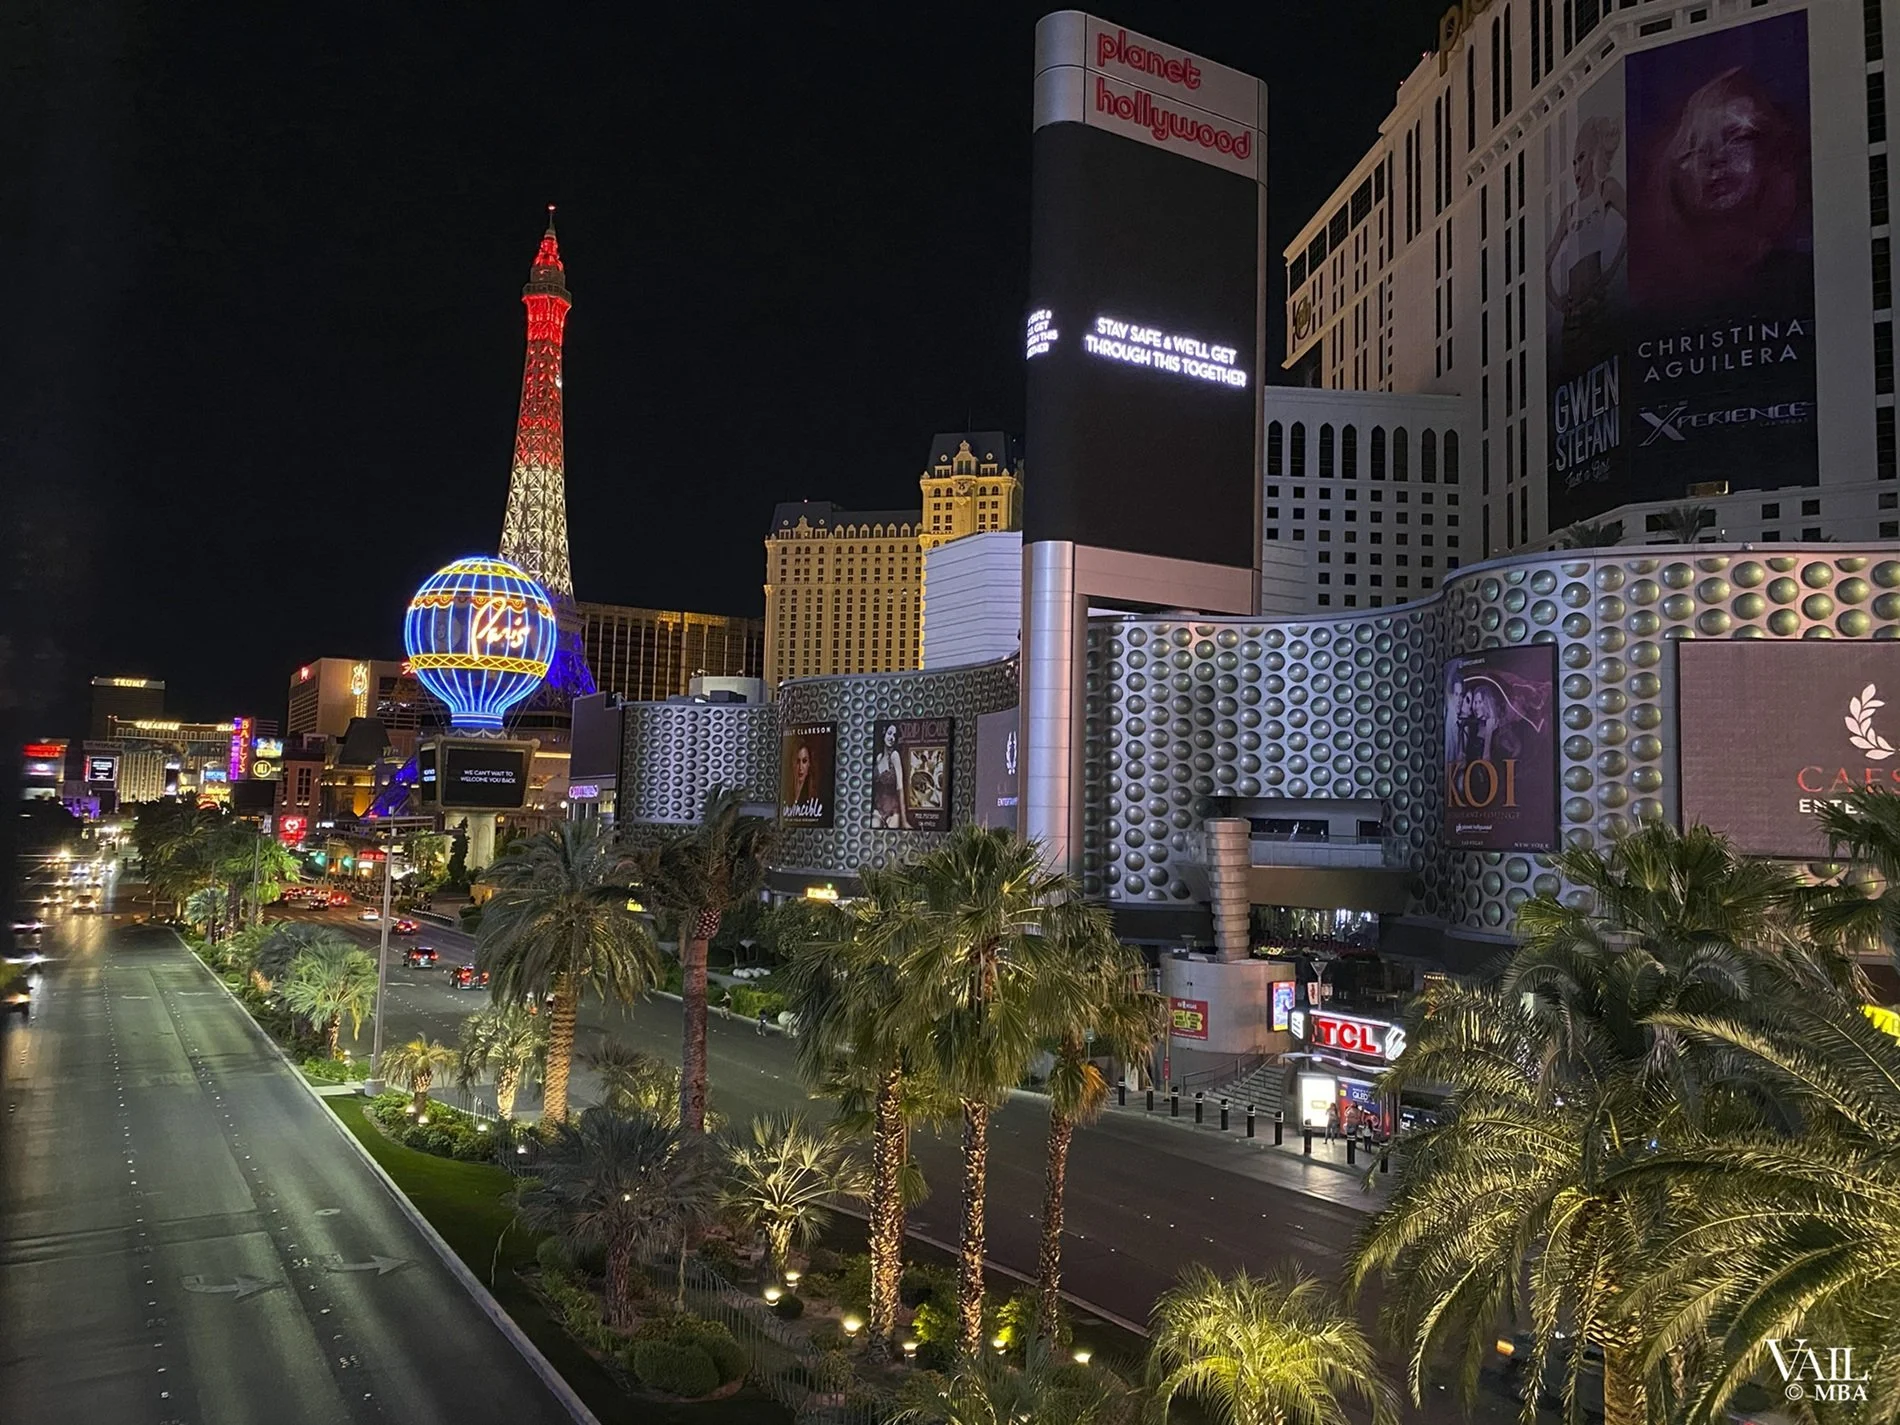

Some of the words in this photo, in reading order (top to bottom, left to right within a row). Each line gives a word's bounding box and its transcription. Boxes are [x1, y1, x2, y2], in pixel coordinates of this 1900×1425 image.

[1097, 29, 1201, 91] planet
[1096, 76, 1252, 160] hollywood
[1085, 335, 1151, 366] THROUGH
[1152, 351, 1181, 374] THIS
[1181, 357, 1247, 388] TOGETHER
[1096, 317, 1131, 340] STAY
[1130, 325, 1162, 348] SAFE
[1163, 335, 1171, 349] &
[1172, 335, 1210, 360] WE'LL
[1211, 345, 1238, 366] GET
[1637, 319, 1805, 359] CHRISTINA
[1643, 343, 1799, 384] AGUILERA
[1554, 354, 1620, 434] GWEN
[1554, 406, 1620, 472] STEFANI
[1637, 401, 1816, 448] XPERIENCE
[471, 596, 531, 662] Paris
[112, 678, 147, 688] TRUMP
[797, 726, 832, 736] CLARKSON
[460, 776, 488, 784] WELCOME
[1447, 758, 1520, 808] KOI
[782, 797, 823, 817] invincible
[1318, 1018, 1380, 1053] TCL
